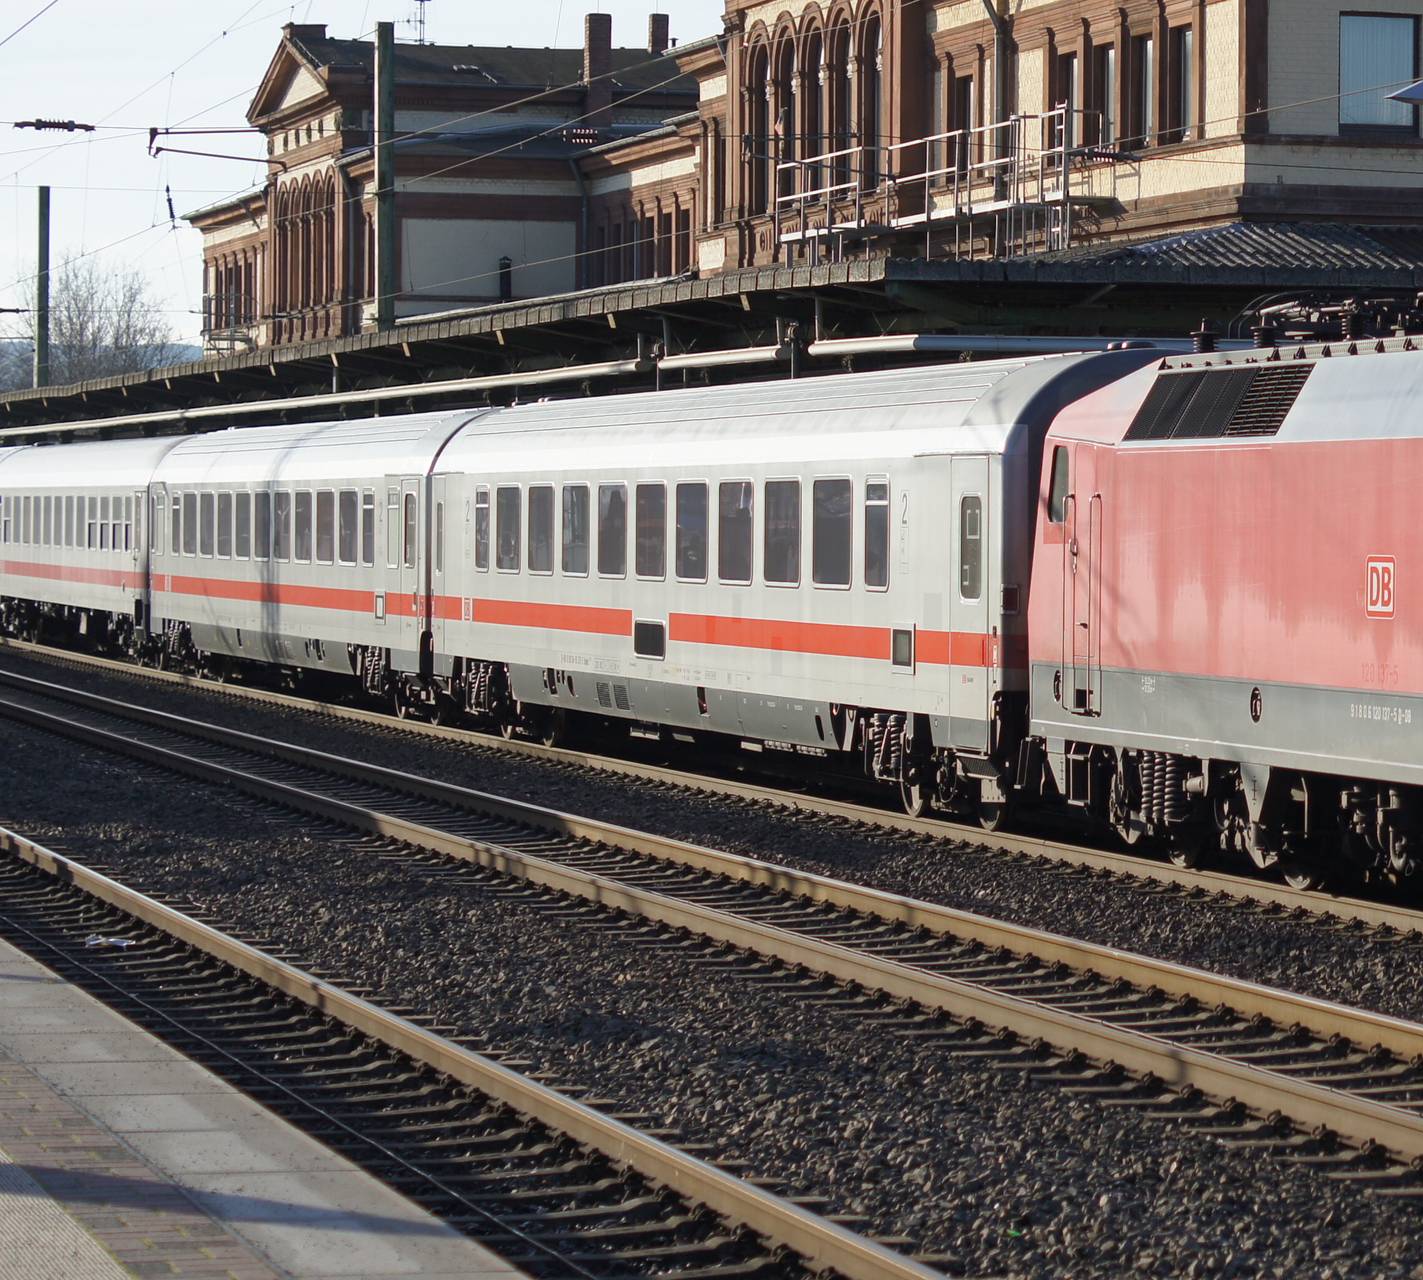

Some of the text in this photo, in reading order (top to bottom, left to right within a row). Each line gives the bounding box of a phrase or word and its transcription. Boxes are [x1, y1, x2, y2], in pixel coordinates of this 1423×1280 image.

[902, 493, 908, 525] 2
[1369, 564, 1393, 609] DB
[1361, 664, 1376, 682] 120
